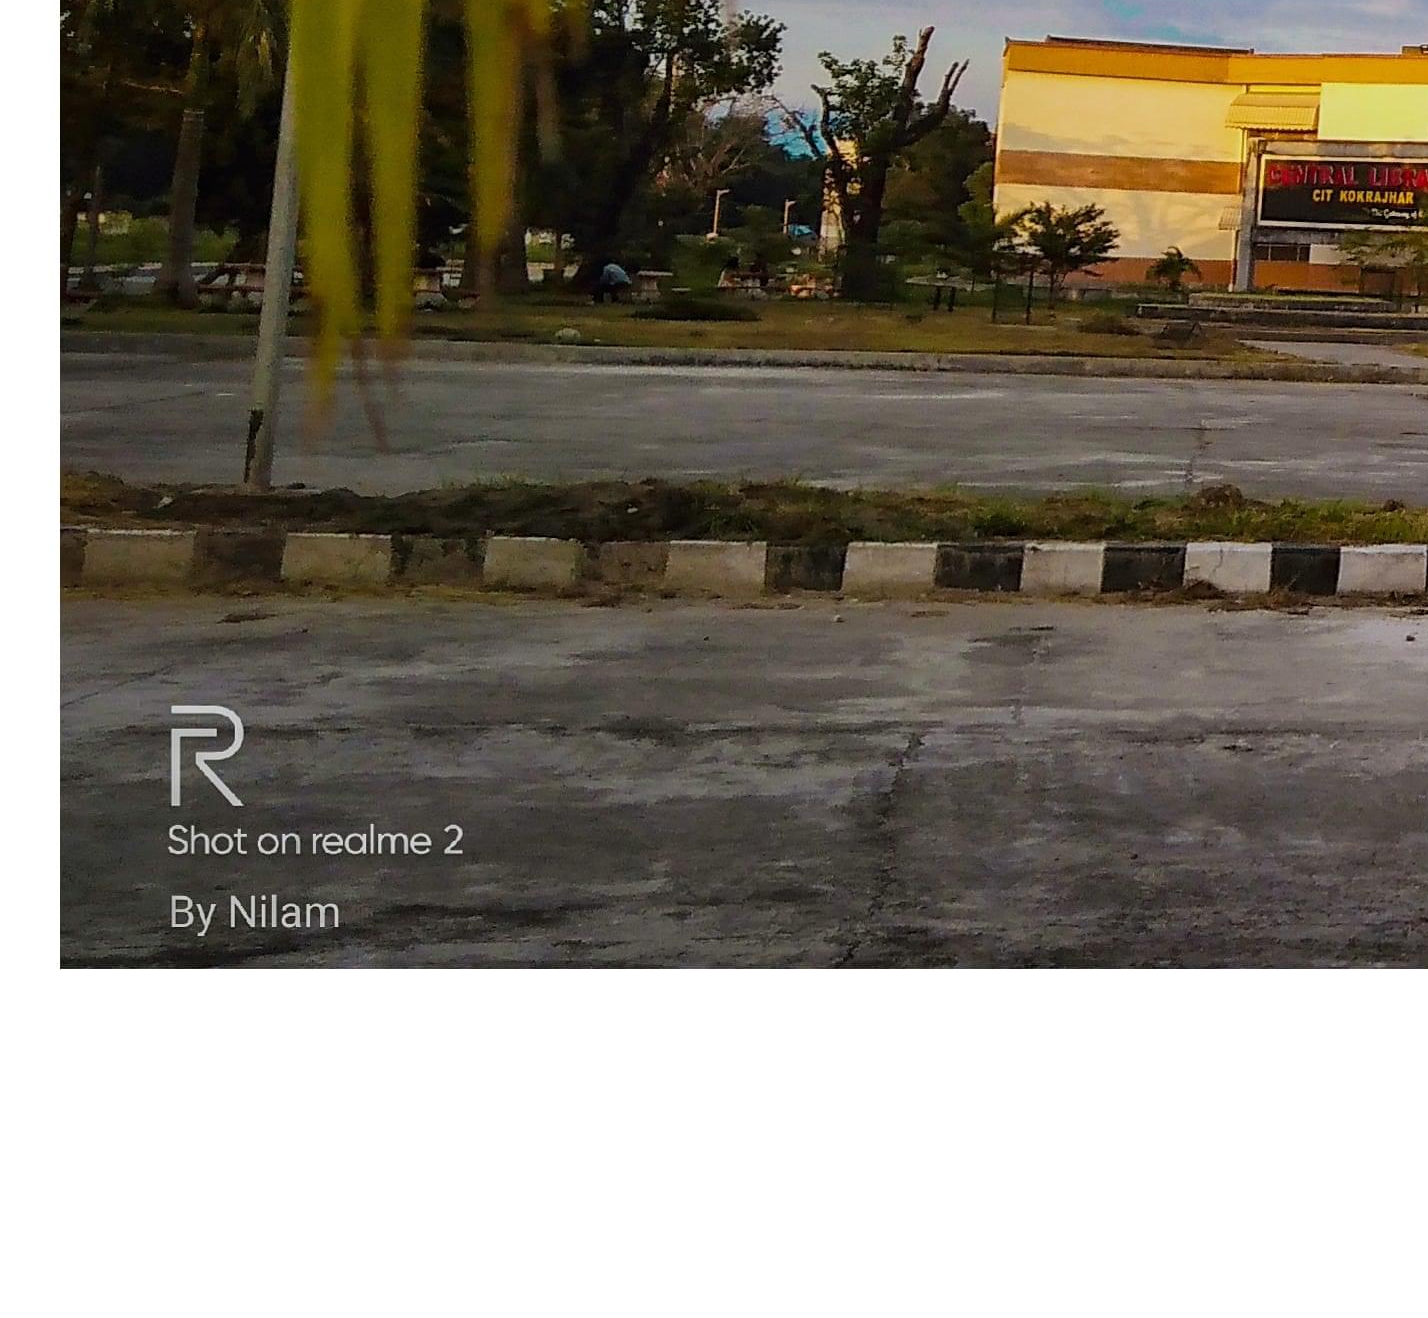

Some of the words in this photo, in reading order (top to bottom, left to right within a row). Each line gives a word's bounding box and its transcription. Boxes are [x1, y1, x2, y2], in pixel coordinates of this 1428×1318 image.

[1267, 163, 1358, 187] CENTRAL
[1312, 189, 1333, 202] CIT
[1340, 190, 1414, 204] KOKRAJHAR
